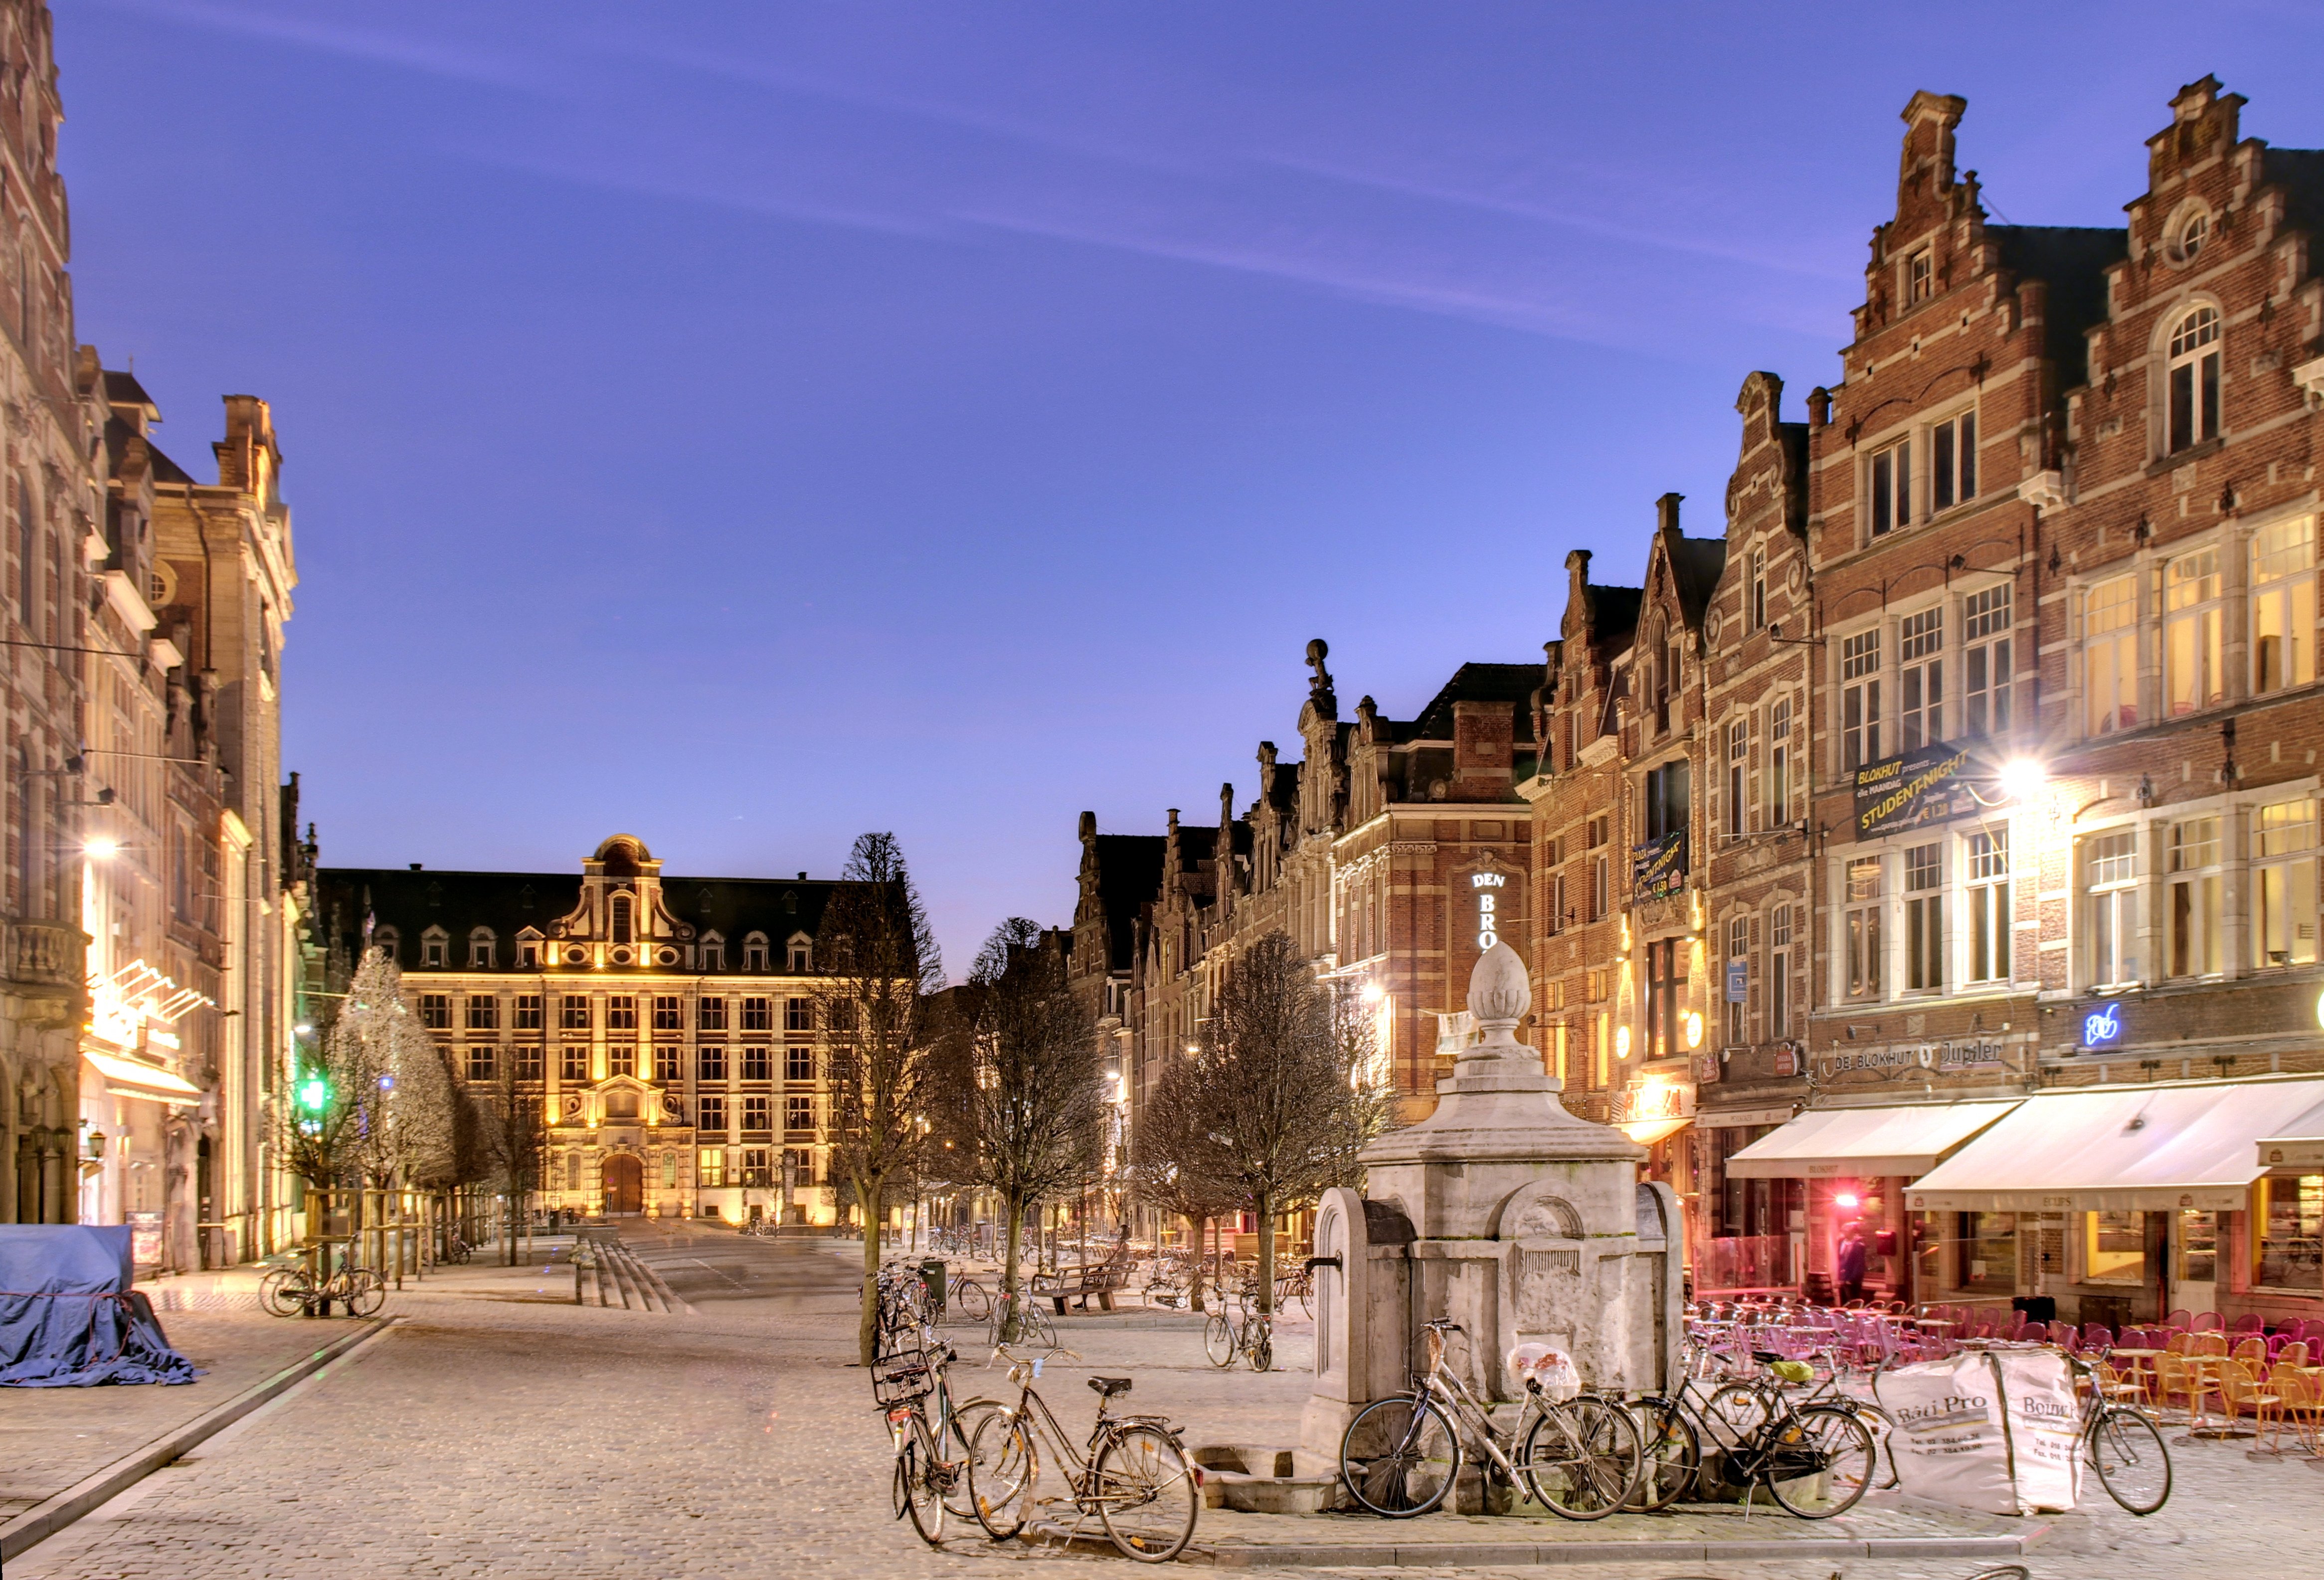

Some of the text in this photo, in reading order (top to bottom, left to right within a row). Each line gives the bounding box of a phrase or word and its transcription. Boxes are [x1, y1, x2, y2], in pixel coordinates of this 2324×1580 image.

[1858, 761, 1902, 784] BLOKHUT
[1862, 748, 1969, 829] STUDENT-NIGHT
[1869, 779, 1901, 794] MAANDAG
[1472, 873, 1506, 888] DEN
[1479, 894, 1497, 954] BRO
[1836, 1051, 1914, 1070] DE BLOKHUT
[1942, 1041, 2002, 1065] Jupiler
[1896, 1396, 1987, 1422] Bâti Pro
[2023, 1397, 2067, 1416] Bouw
